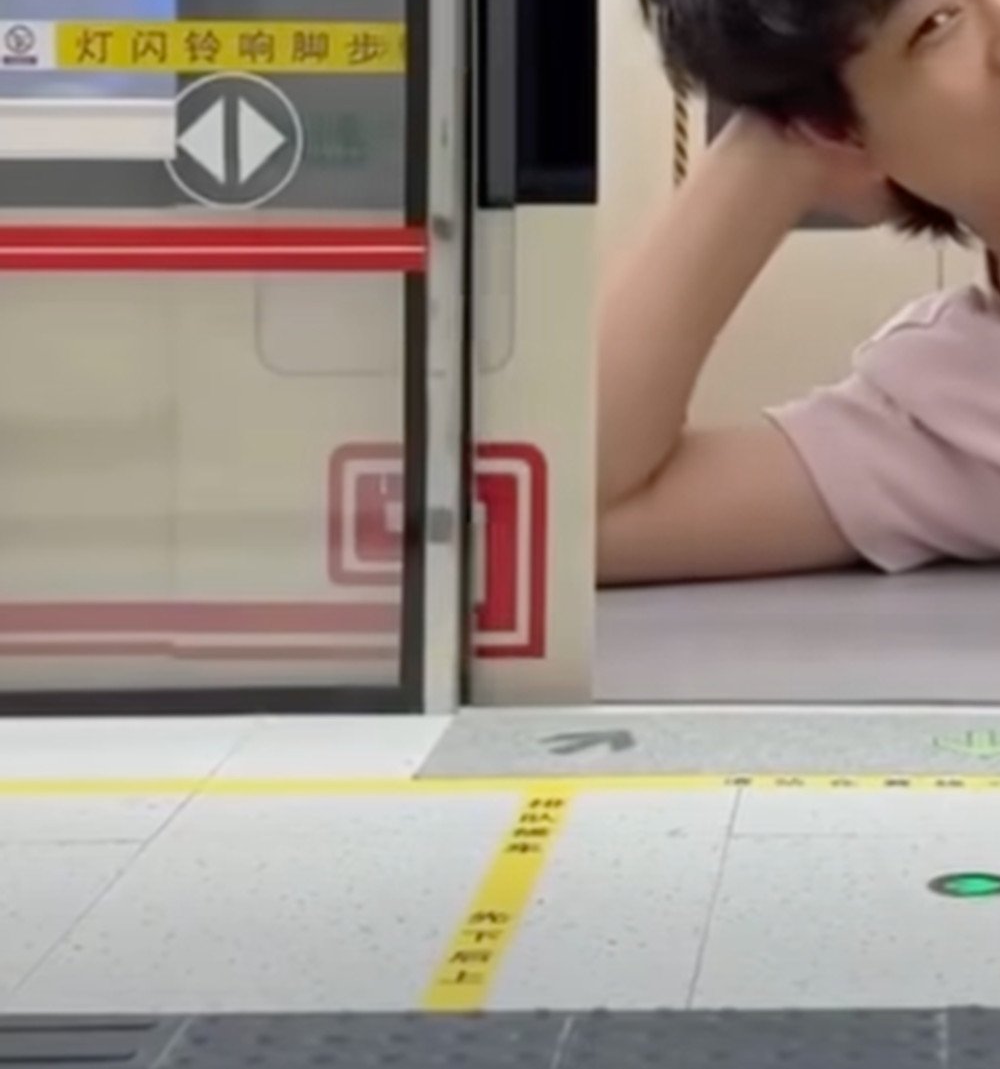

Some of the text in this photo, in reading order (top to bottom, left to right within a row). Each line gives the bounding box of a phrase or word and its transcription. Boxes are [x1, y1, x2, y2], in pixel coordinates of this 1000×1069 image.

[76, 31, 386, 65] 灯闪铃响脚步
